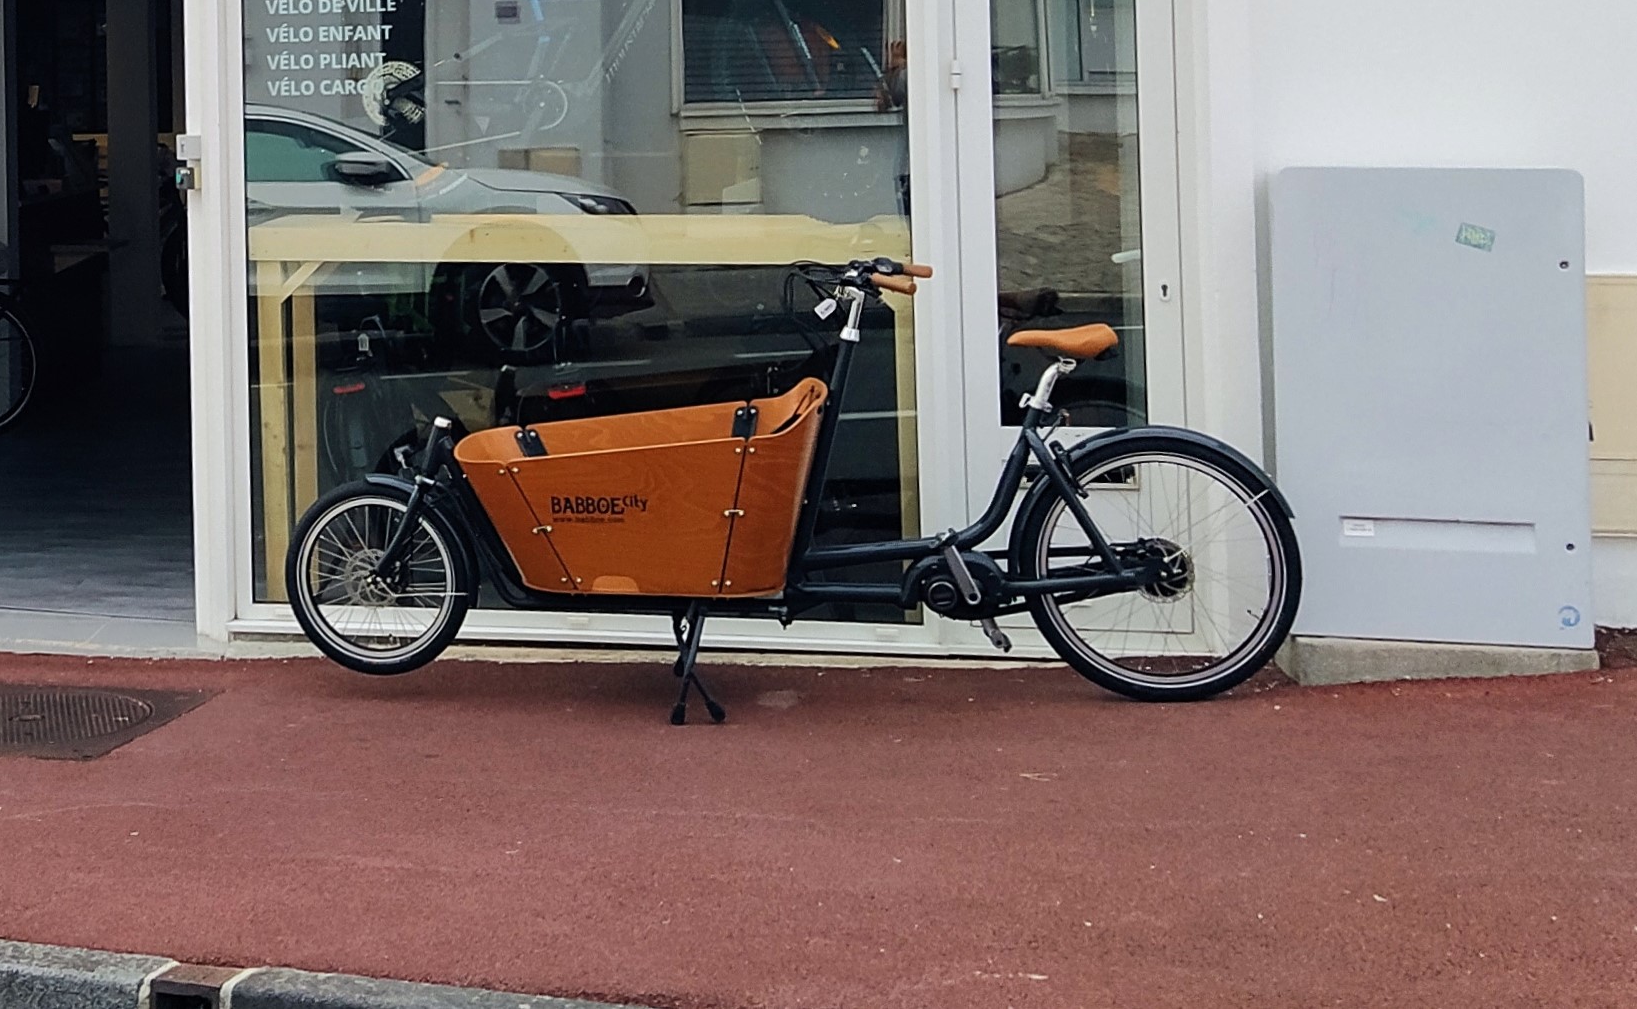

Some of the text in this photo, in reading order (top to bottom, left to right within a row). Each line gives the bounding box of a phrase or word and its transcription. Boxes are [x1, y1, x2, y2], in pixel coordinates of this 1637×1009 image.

[266, 22, 393, 42] VÉLO ENFANT
[267, 50, 387, 69] VÉLO PLIANT
[267, 76, 386, 96] VÉLO CARGO
[551, 496, 624, 515] BABBOE
